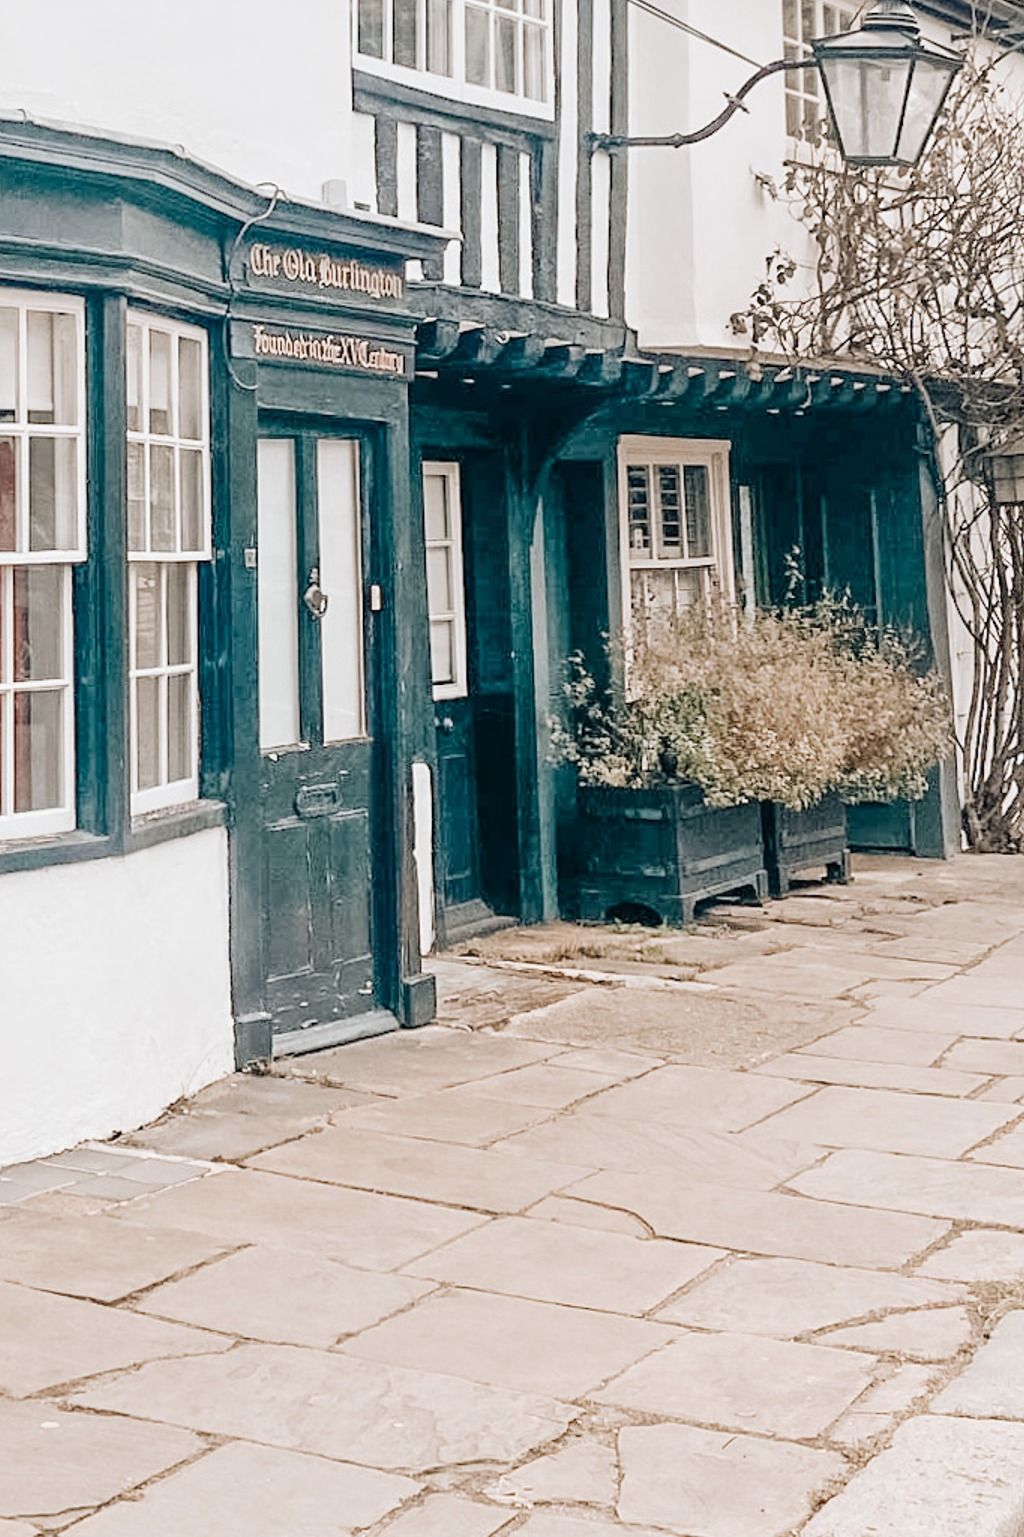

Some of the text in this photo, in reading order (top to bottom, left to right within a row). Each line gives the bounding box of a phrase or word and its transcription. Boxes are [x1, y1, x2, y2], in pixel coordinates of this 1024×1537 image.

[250, 243, 403, 299] The Old Burlington
[251, 323, 308, 359] Founded
[340, 336, 361, 366] XV
